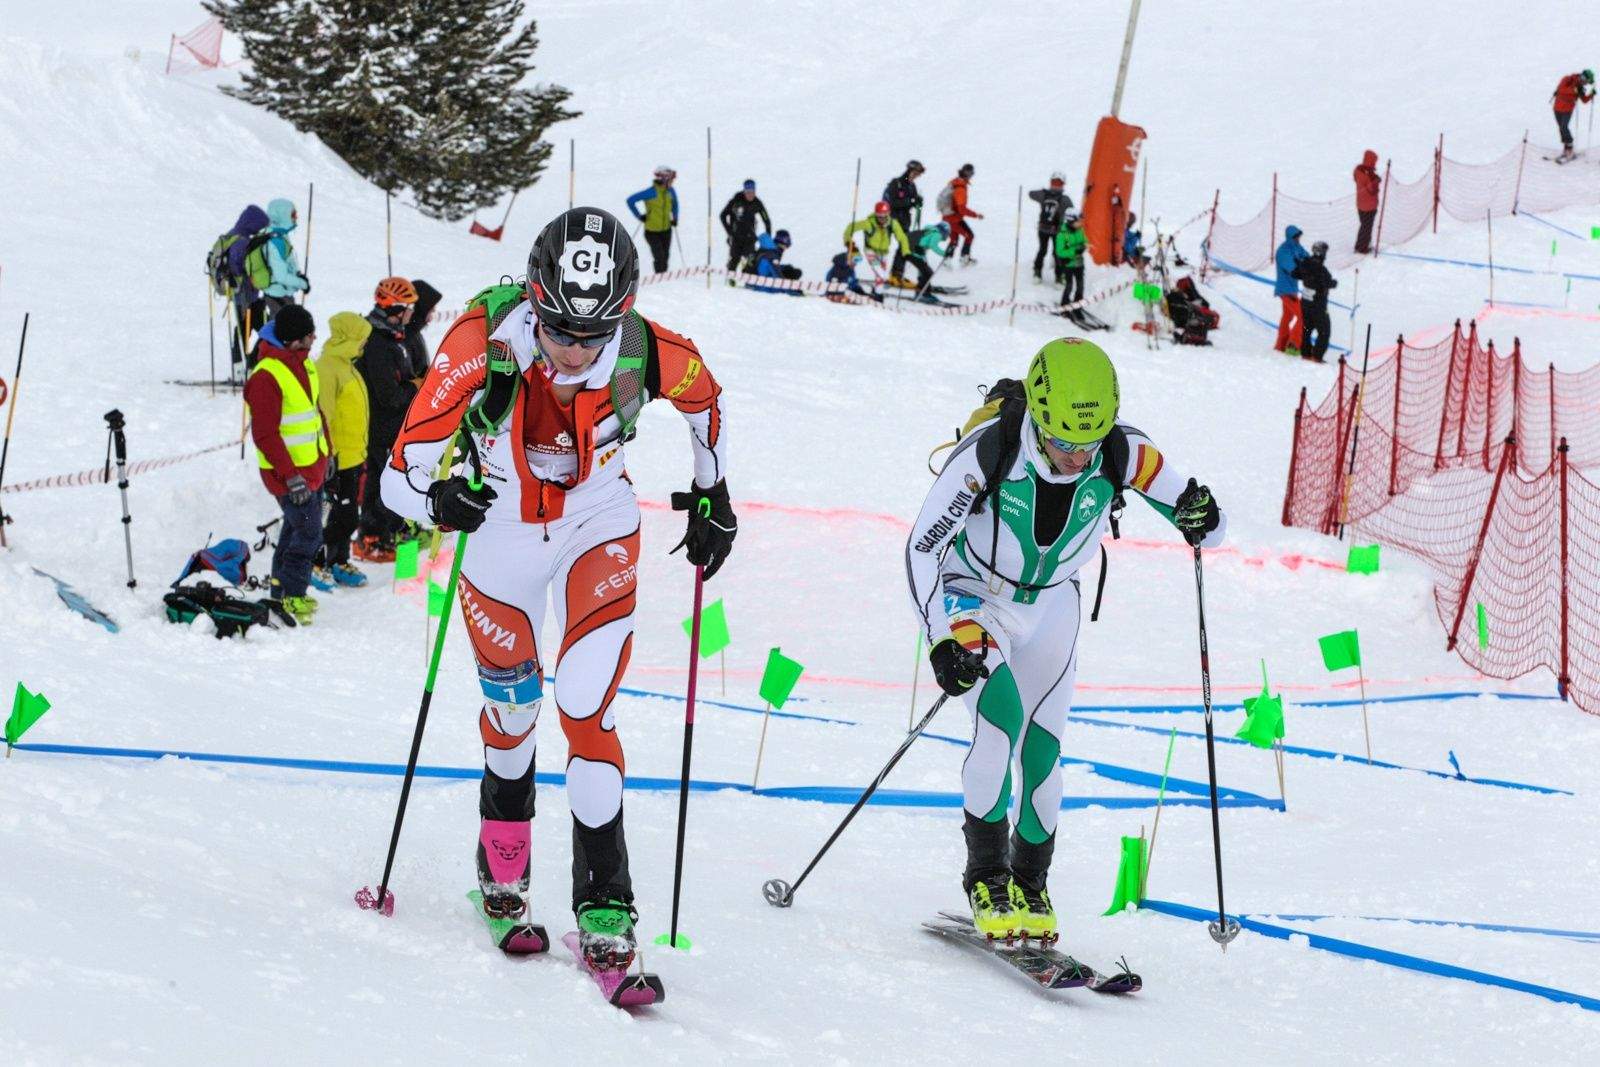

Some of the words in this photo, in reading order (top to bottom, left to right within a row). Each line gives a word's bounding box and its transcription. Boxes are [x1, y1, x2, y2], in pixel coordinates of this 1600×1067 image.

[572, 250, 601, 274] G!
[1072, 401, 1099, 409] GUARDIA
[1000, 489, 1030, 511] GUARDIA
[1002, 504, 1021, 517] CIVIL
[915, 515, 957, 553] GUARDIA
[948, 490, 972, 518] CIVIL
[947, 595, 962, 616] 2
[503, 687, 517, 704] 1
